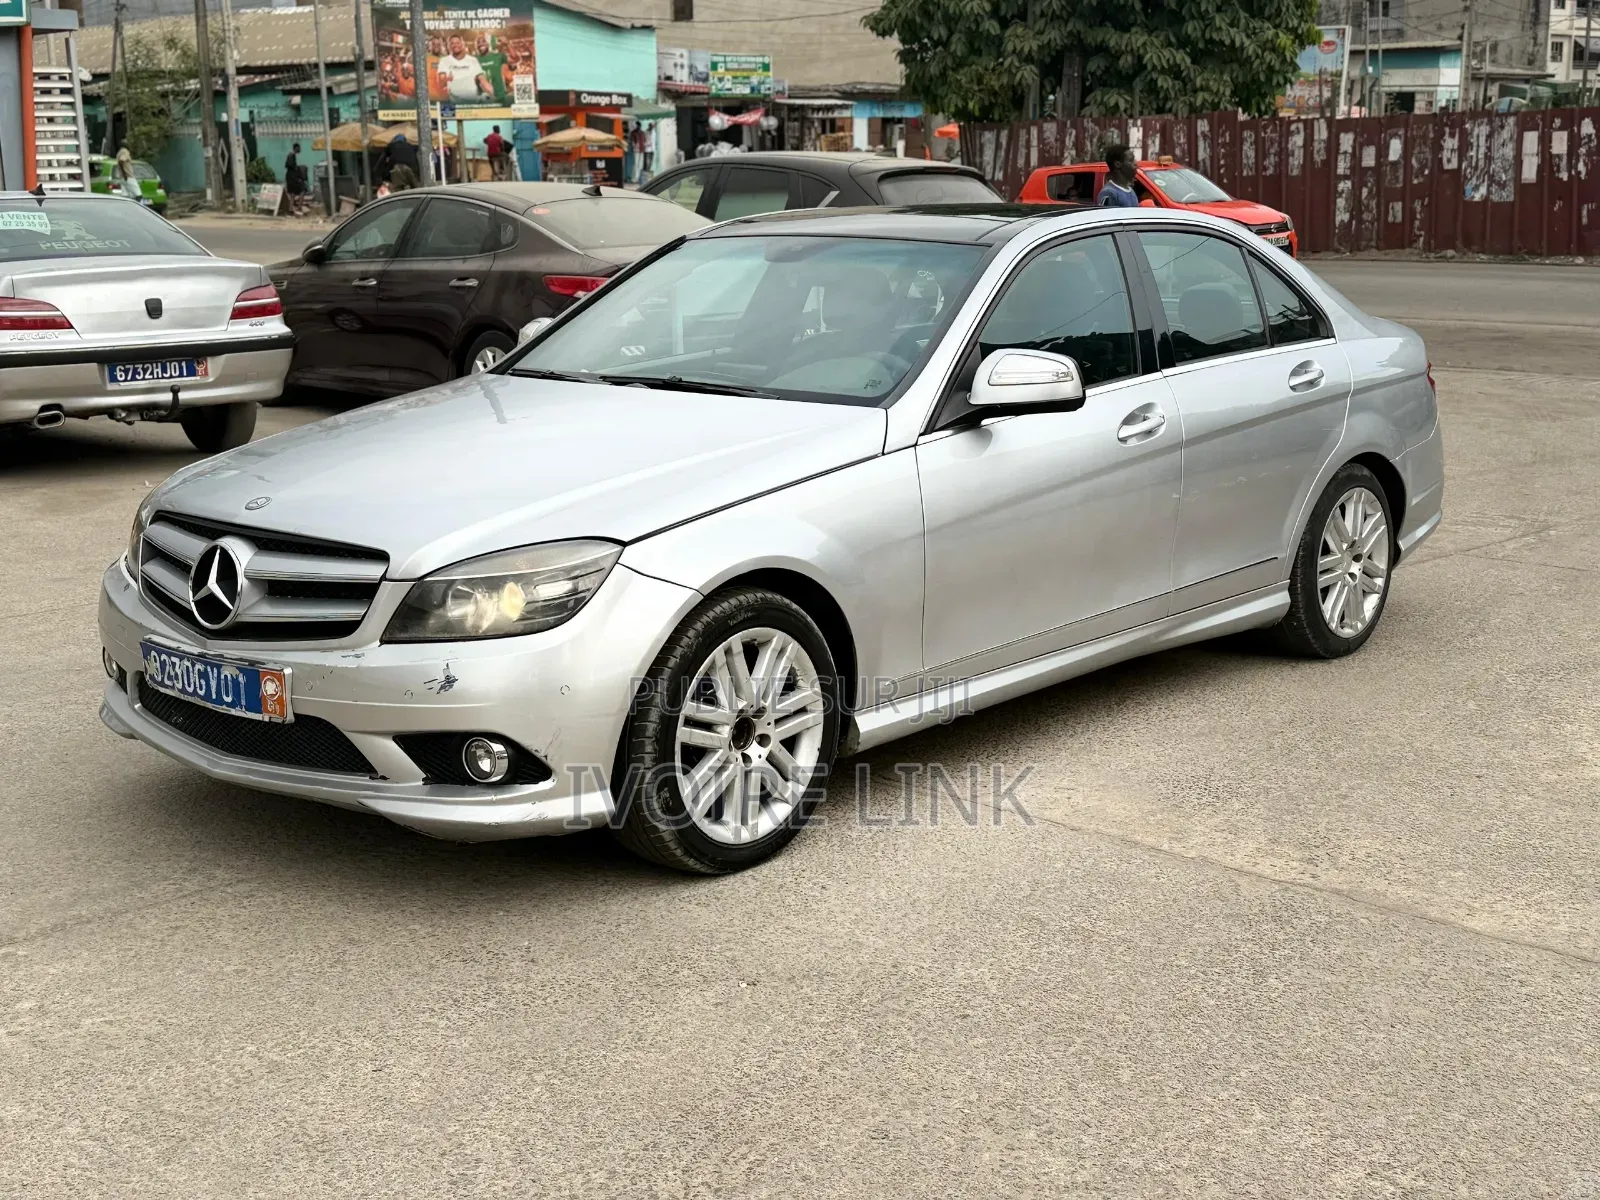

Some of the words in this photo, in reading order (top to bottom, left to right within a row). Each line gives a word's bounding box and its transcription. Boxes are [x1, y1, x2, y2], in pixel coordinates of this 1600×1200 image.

[444, 11, 466, 19] TENTE
[477, 8, 510, 18] GAGNER
[459, 20, 471, 29] AU
[472, 18, 500, 28] MAROC
[581, 93, 611, 106] Orange
[611, 94, 628, 104] Box
[7, 213, 46, 221] VENTE
[39, 240, 131, 250] PEUGEOT
[9, 332, 61, 341] PEUGEOT
[115, 360, 188, 381] 6732HJ01
